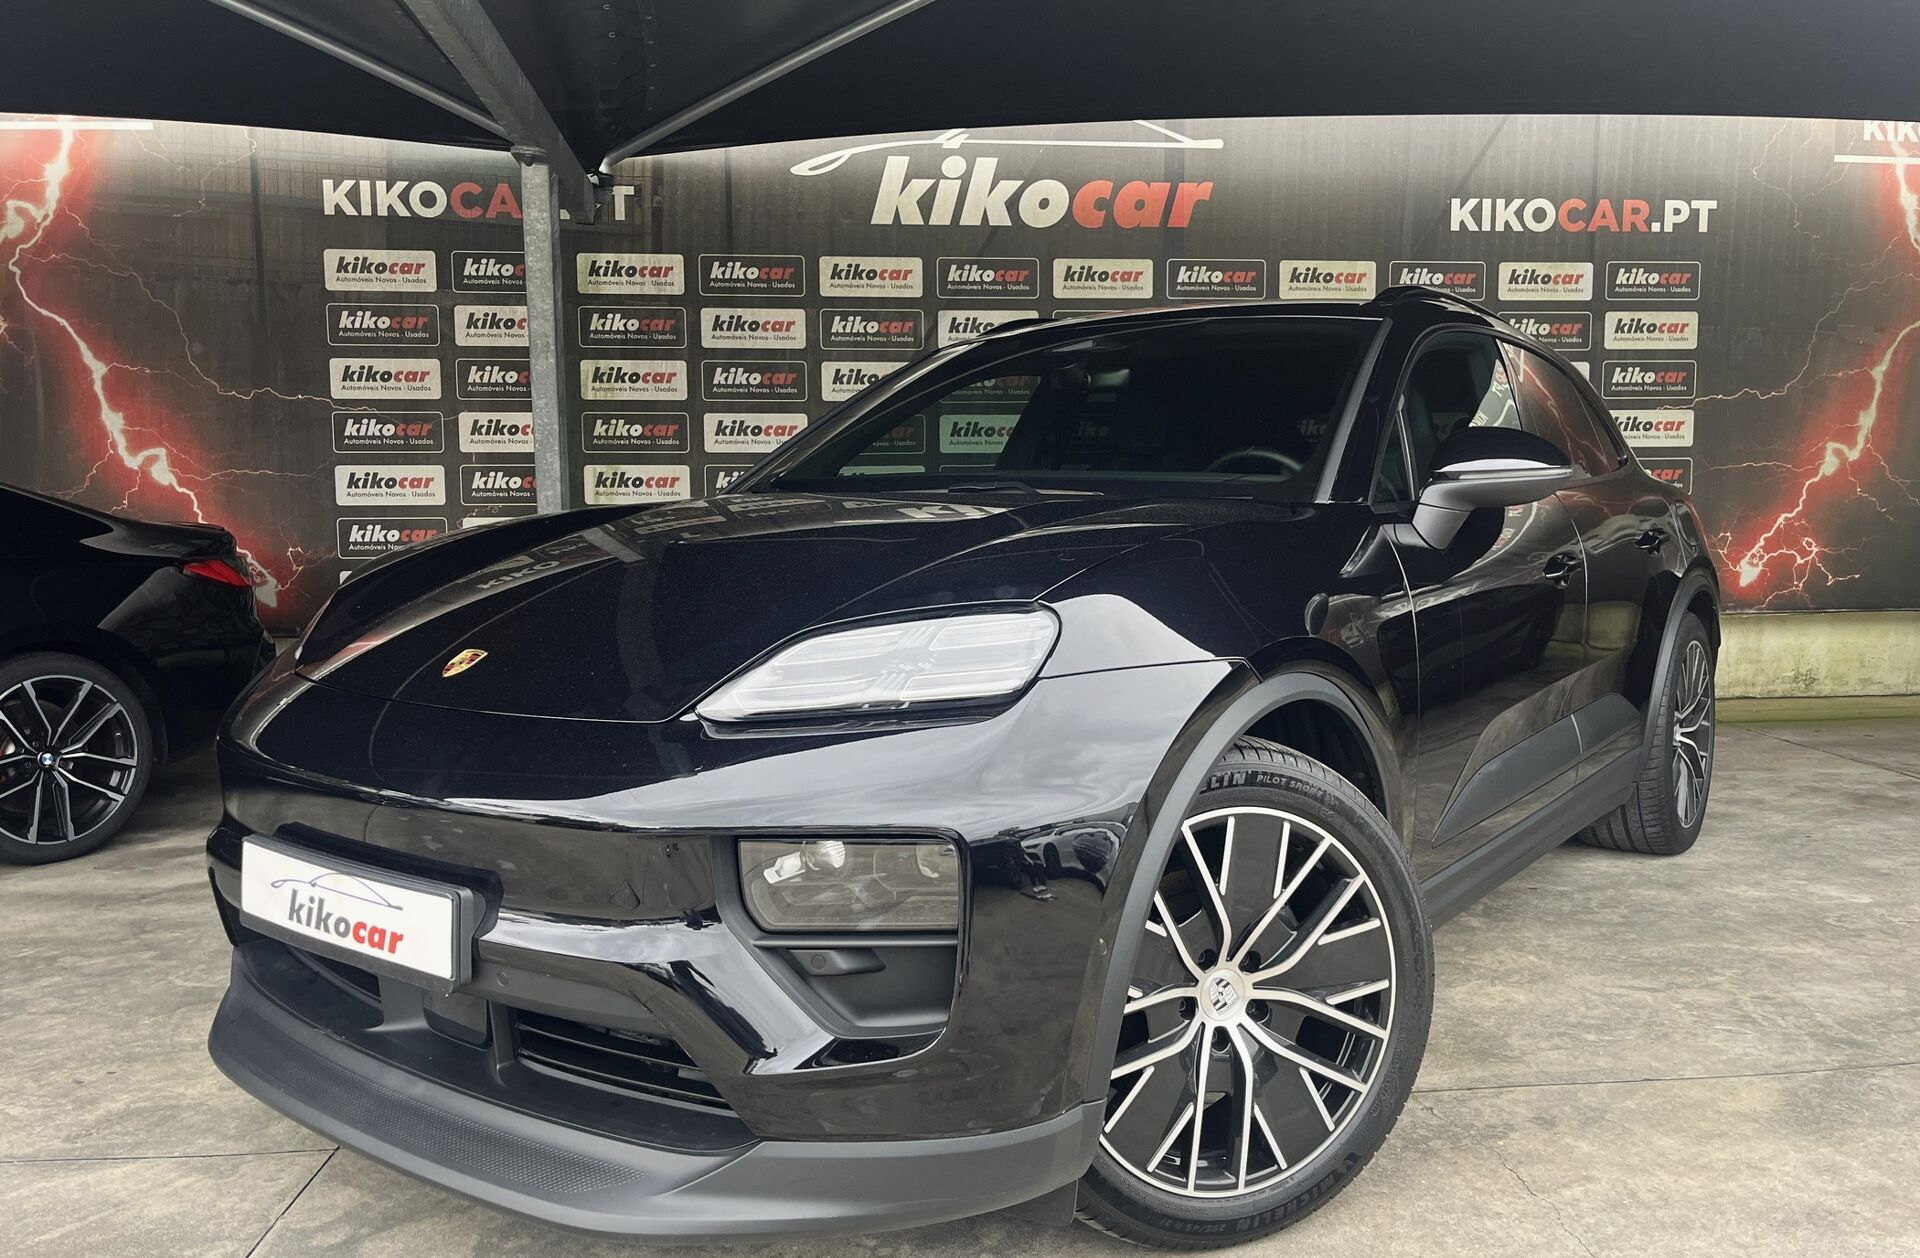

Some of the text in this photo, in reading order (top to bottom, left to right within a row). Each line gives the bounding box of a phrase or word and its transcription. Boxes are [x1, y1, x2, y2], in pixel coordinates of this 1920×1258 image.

[1863, 120, 1920, 142] KIK
[322, 178, 635, 221] KIKOCAT
[870, 155, 1213, 229] kikocar
[1450, 198, 1718, 233] KIKOCAR.PT
[336, 256, 425, 274] kikocar
[463, 258, 525, 276] kikoc
[588, 260, 673, 278] kikocar
[710, 262, 794, 279] kikocar
[830, 264, 912, 281] kikocar
[948, 265, 1029, 282] kikocar
[1063, 266, 1144, 282] kikocar
[1177, 266, 1256, 283] kikocar
[1290, 267, 1367, 284] kikocar
[1400, 268, 1476, 284] kikocar
[1508, 269, 1584, 284] kikocar
[1616, 268, 1691, 284] kikocar
[339, 311, 428, 329] kikocar
[466, 312, 527, 330] kikoc
[590, 313, 675, 331] kikocar
[712, 315, 795, 332] kikocar
[831, 316, 913, 333] kikocar
[1615, 318, 1689, 334] kikocar
[342, 365, 430, 382] kikocar
[468, 366, 530, 384] kikoc
[592, 367, 677, 384] kikocar
[713, 368, 797, 385] kikocar
[832, 369, 880, 385] kiko
[1612, 367, 1687, 383] kikocar
[344, 419, 432, 437] kikocar
[470, 419, 534, 436] kikoc
[593, 419, 678, 437] kikocar
[715, 420, 797, 437] kikocar
[950, 421, 1014, 438] kikoc
[347, 472, 434, 489] kikocar
[472, 472, 536, 489] kikoc
[595, 472, 679, 489] kikocar
[349, 525, 437, 542] kikocar
[288, 888, 404, 954] kikocar
